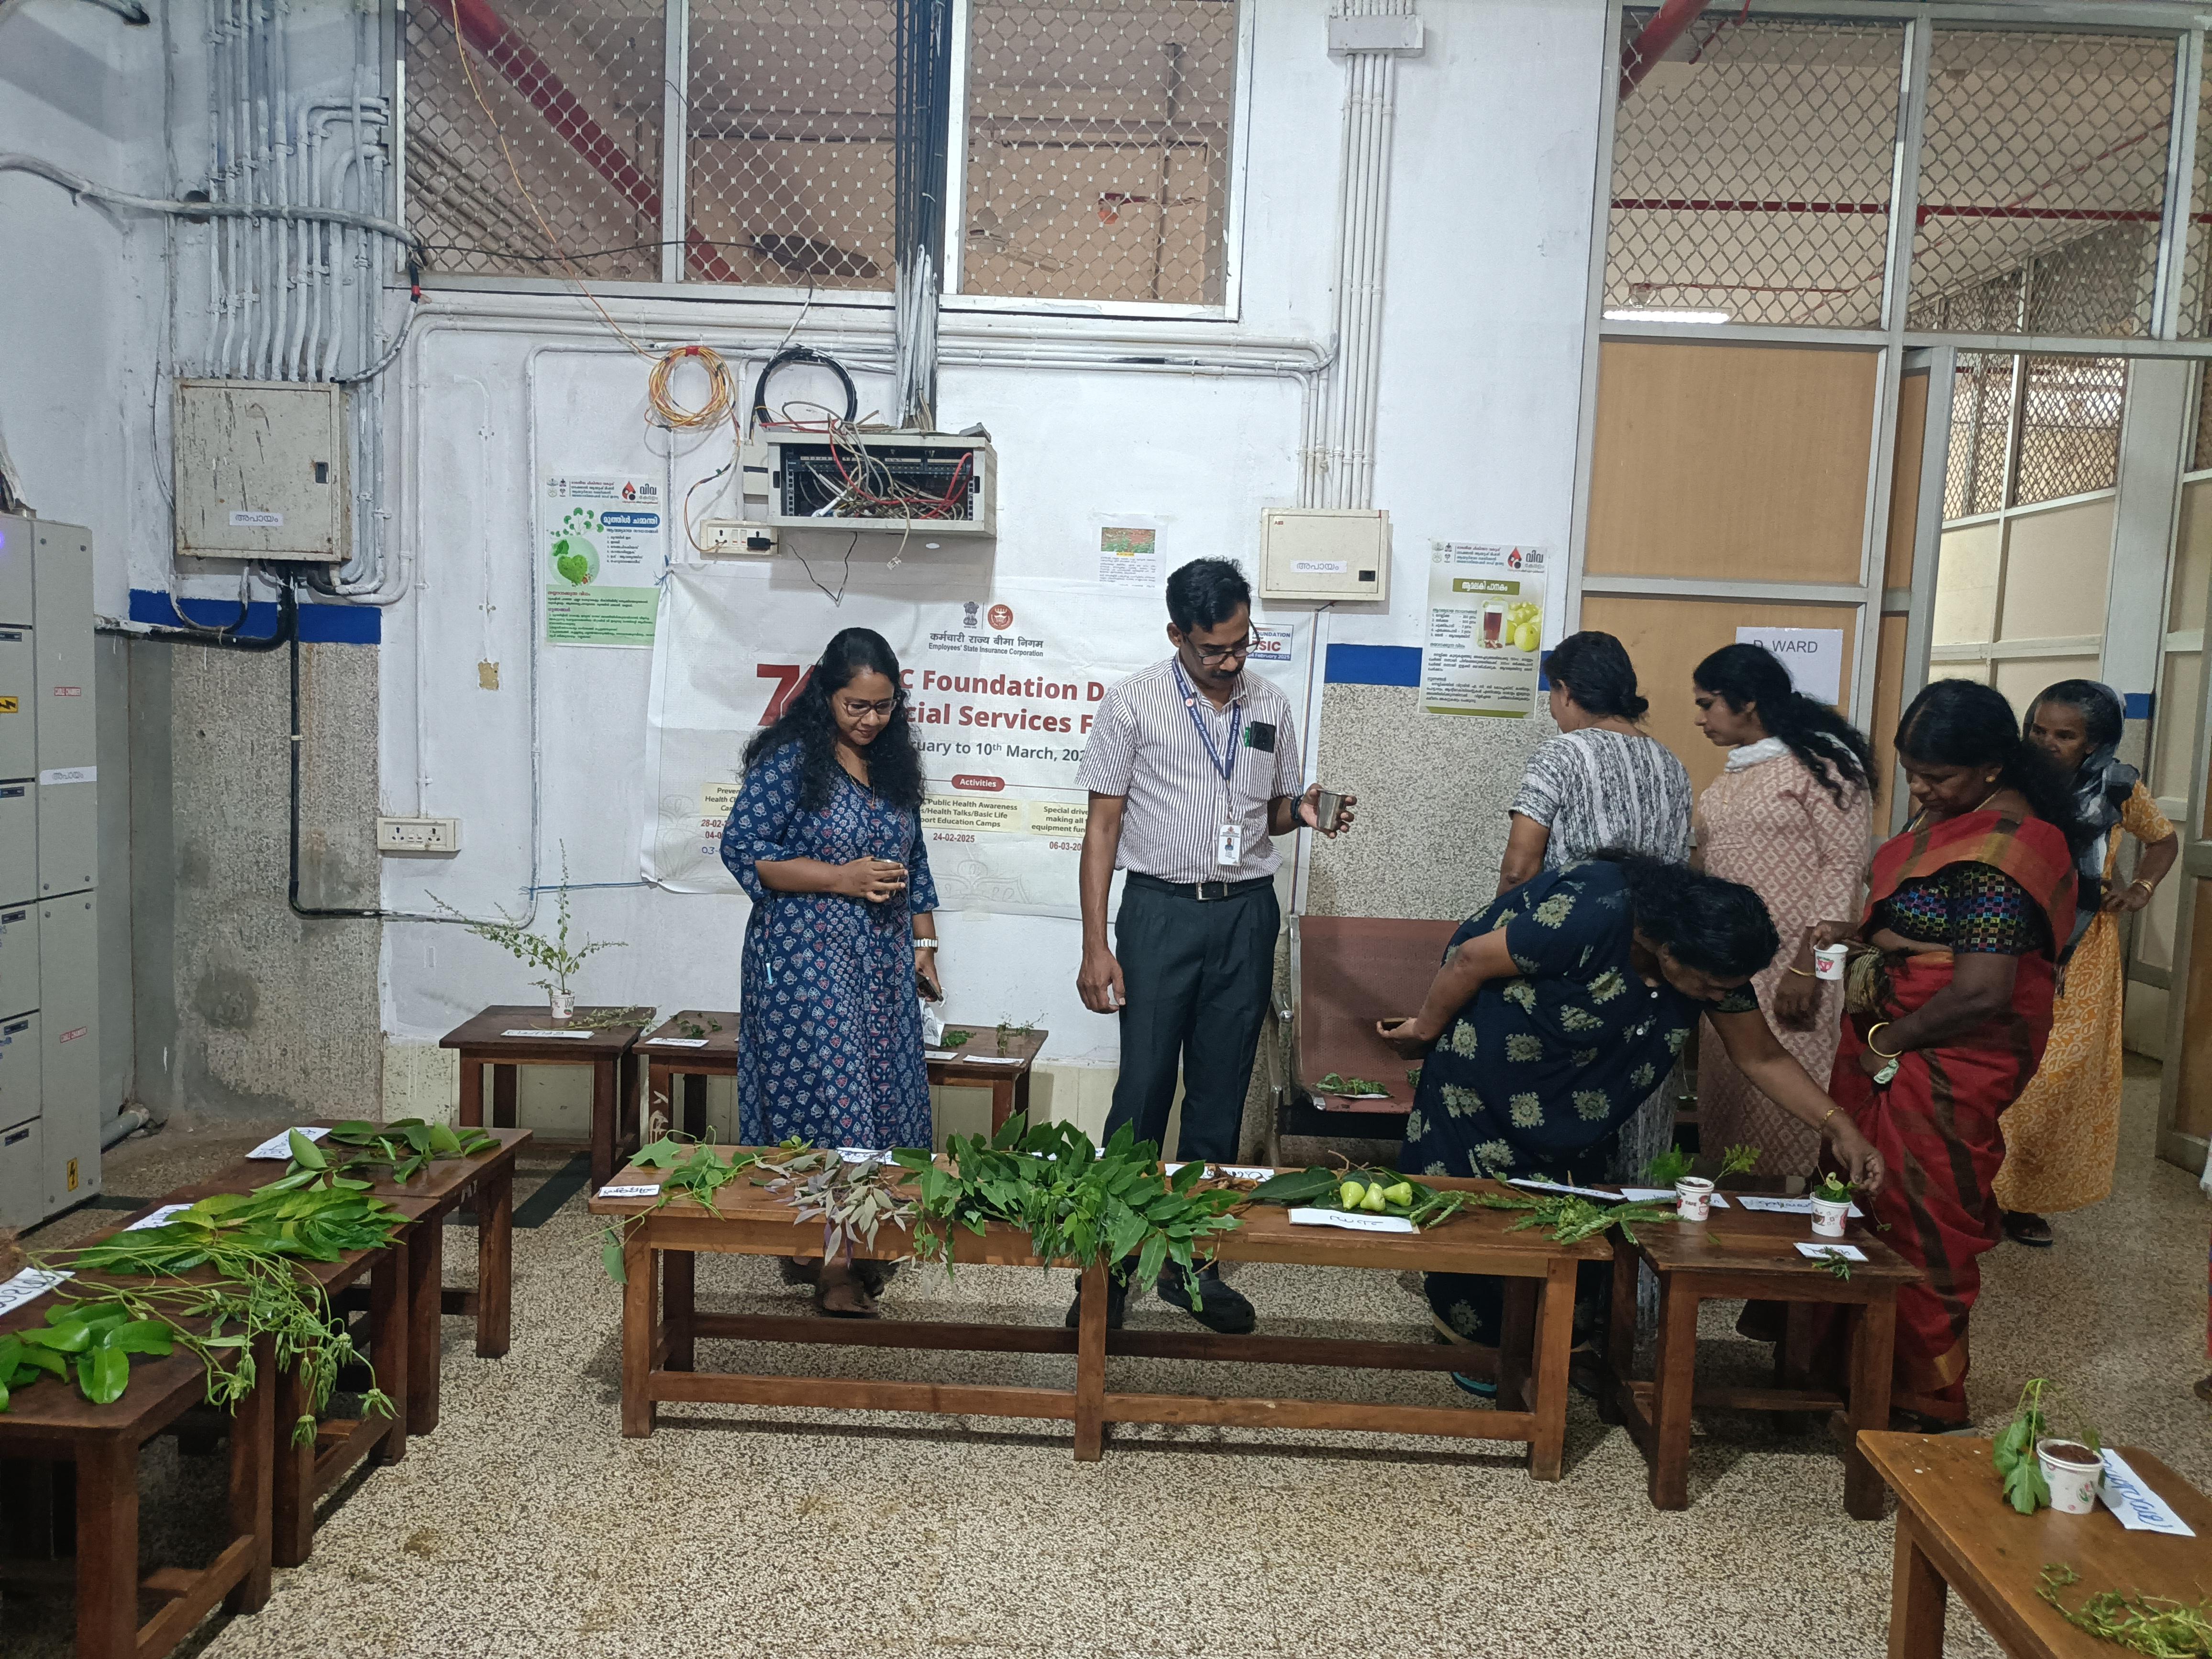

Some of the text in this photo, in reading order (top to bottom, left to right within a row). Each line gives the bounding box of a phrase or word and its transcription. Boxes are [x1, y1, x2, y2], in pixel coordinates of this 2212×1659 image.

[640, 483, 657, 495] വിവ
[235, 513, 279, 523] അപായം
[604, 515, 630, 525] മുത്തിൾ
[1526, 550, 1543, 563] വിവ
[1296, 562, 1339, 571] അപായം
[1462, 581, 1486, 591] ആമലകി
[930, 630, 1043, 648] कर्मचारी राज्य बीमा निगम
[929, 643, 962, 652] Employees'
[980, 646, 1007, 654] Insurance
[1009, 648, 1043, 657] Corporation
[1772, 640, 1818, 653] WARD
[923, 670, 1077, 700] Foundation
[959, 706, 1072, 733] Services
[1228, 730, 1237, 760] GOVERNMENT
[912, 741, 951, 756] ruary
[956, 742, 971, 754] to
[976, 742, 1002, 756] 10th
[1006, 745, 1057, 762] March,
[960, 778, 996, 787] Activities
[979, 802, 1018, 810] Awareness
[953, 809, 993, 818] Talks/Basic
[701, 819, 727, 828] 28-02-
[937, 818, 974, 826] Education
[933, 833, 975, 842] 24-02-2025
[1050, 841, 1081, 851] 06-03-20
